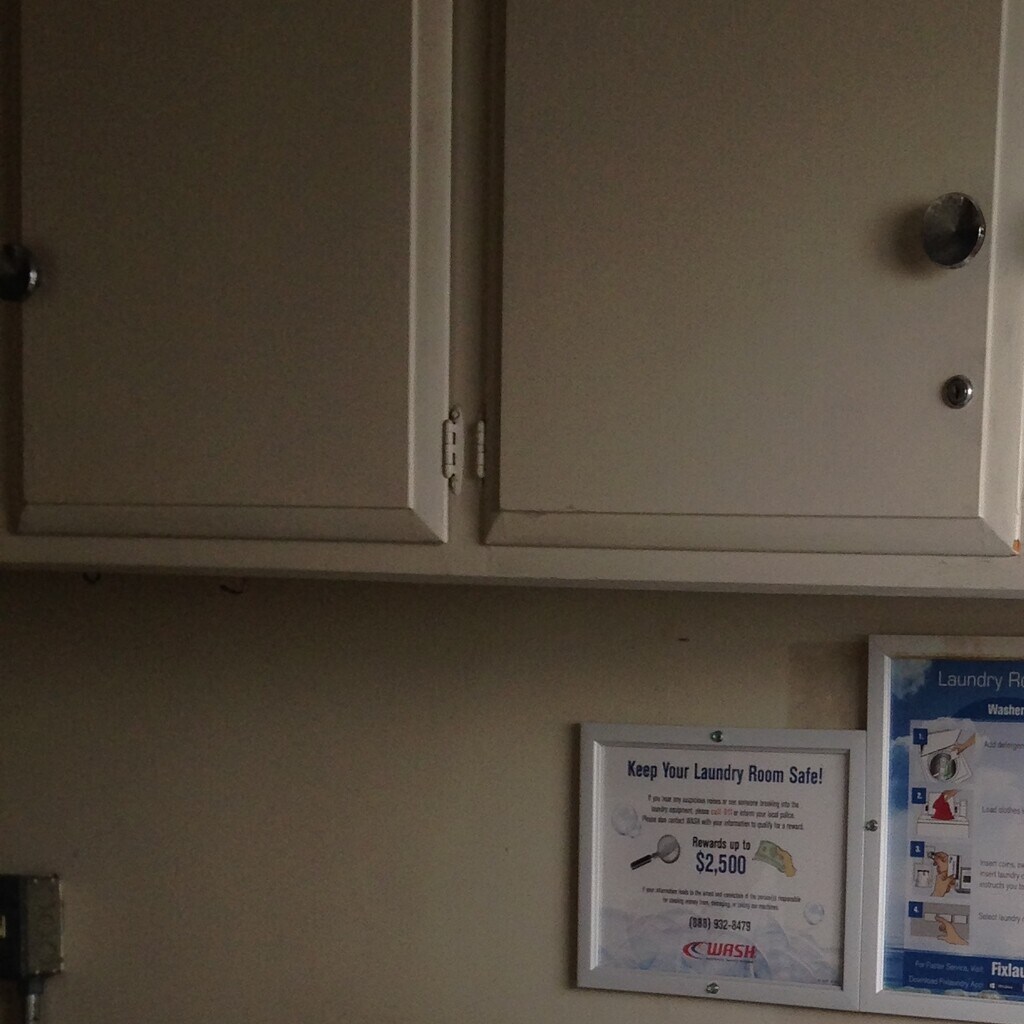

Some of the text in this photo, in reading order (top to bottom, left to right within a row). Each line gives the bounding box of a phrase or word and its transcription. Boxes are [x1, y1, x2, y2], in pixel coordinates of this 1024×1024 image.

[939, 671, 1003, 691] Laundry
[988, 704, 1024, 716] Washer
[628, 761, 822, 784] Keep Your Laundry Room Safe!
[693, 837, 750, 851] Rewards up to
[696, 851, 746, 876] $2,500
[689, 917, 750, 931] (888) 932-8479
[707, 942, 756, 957] WASH
